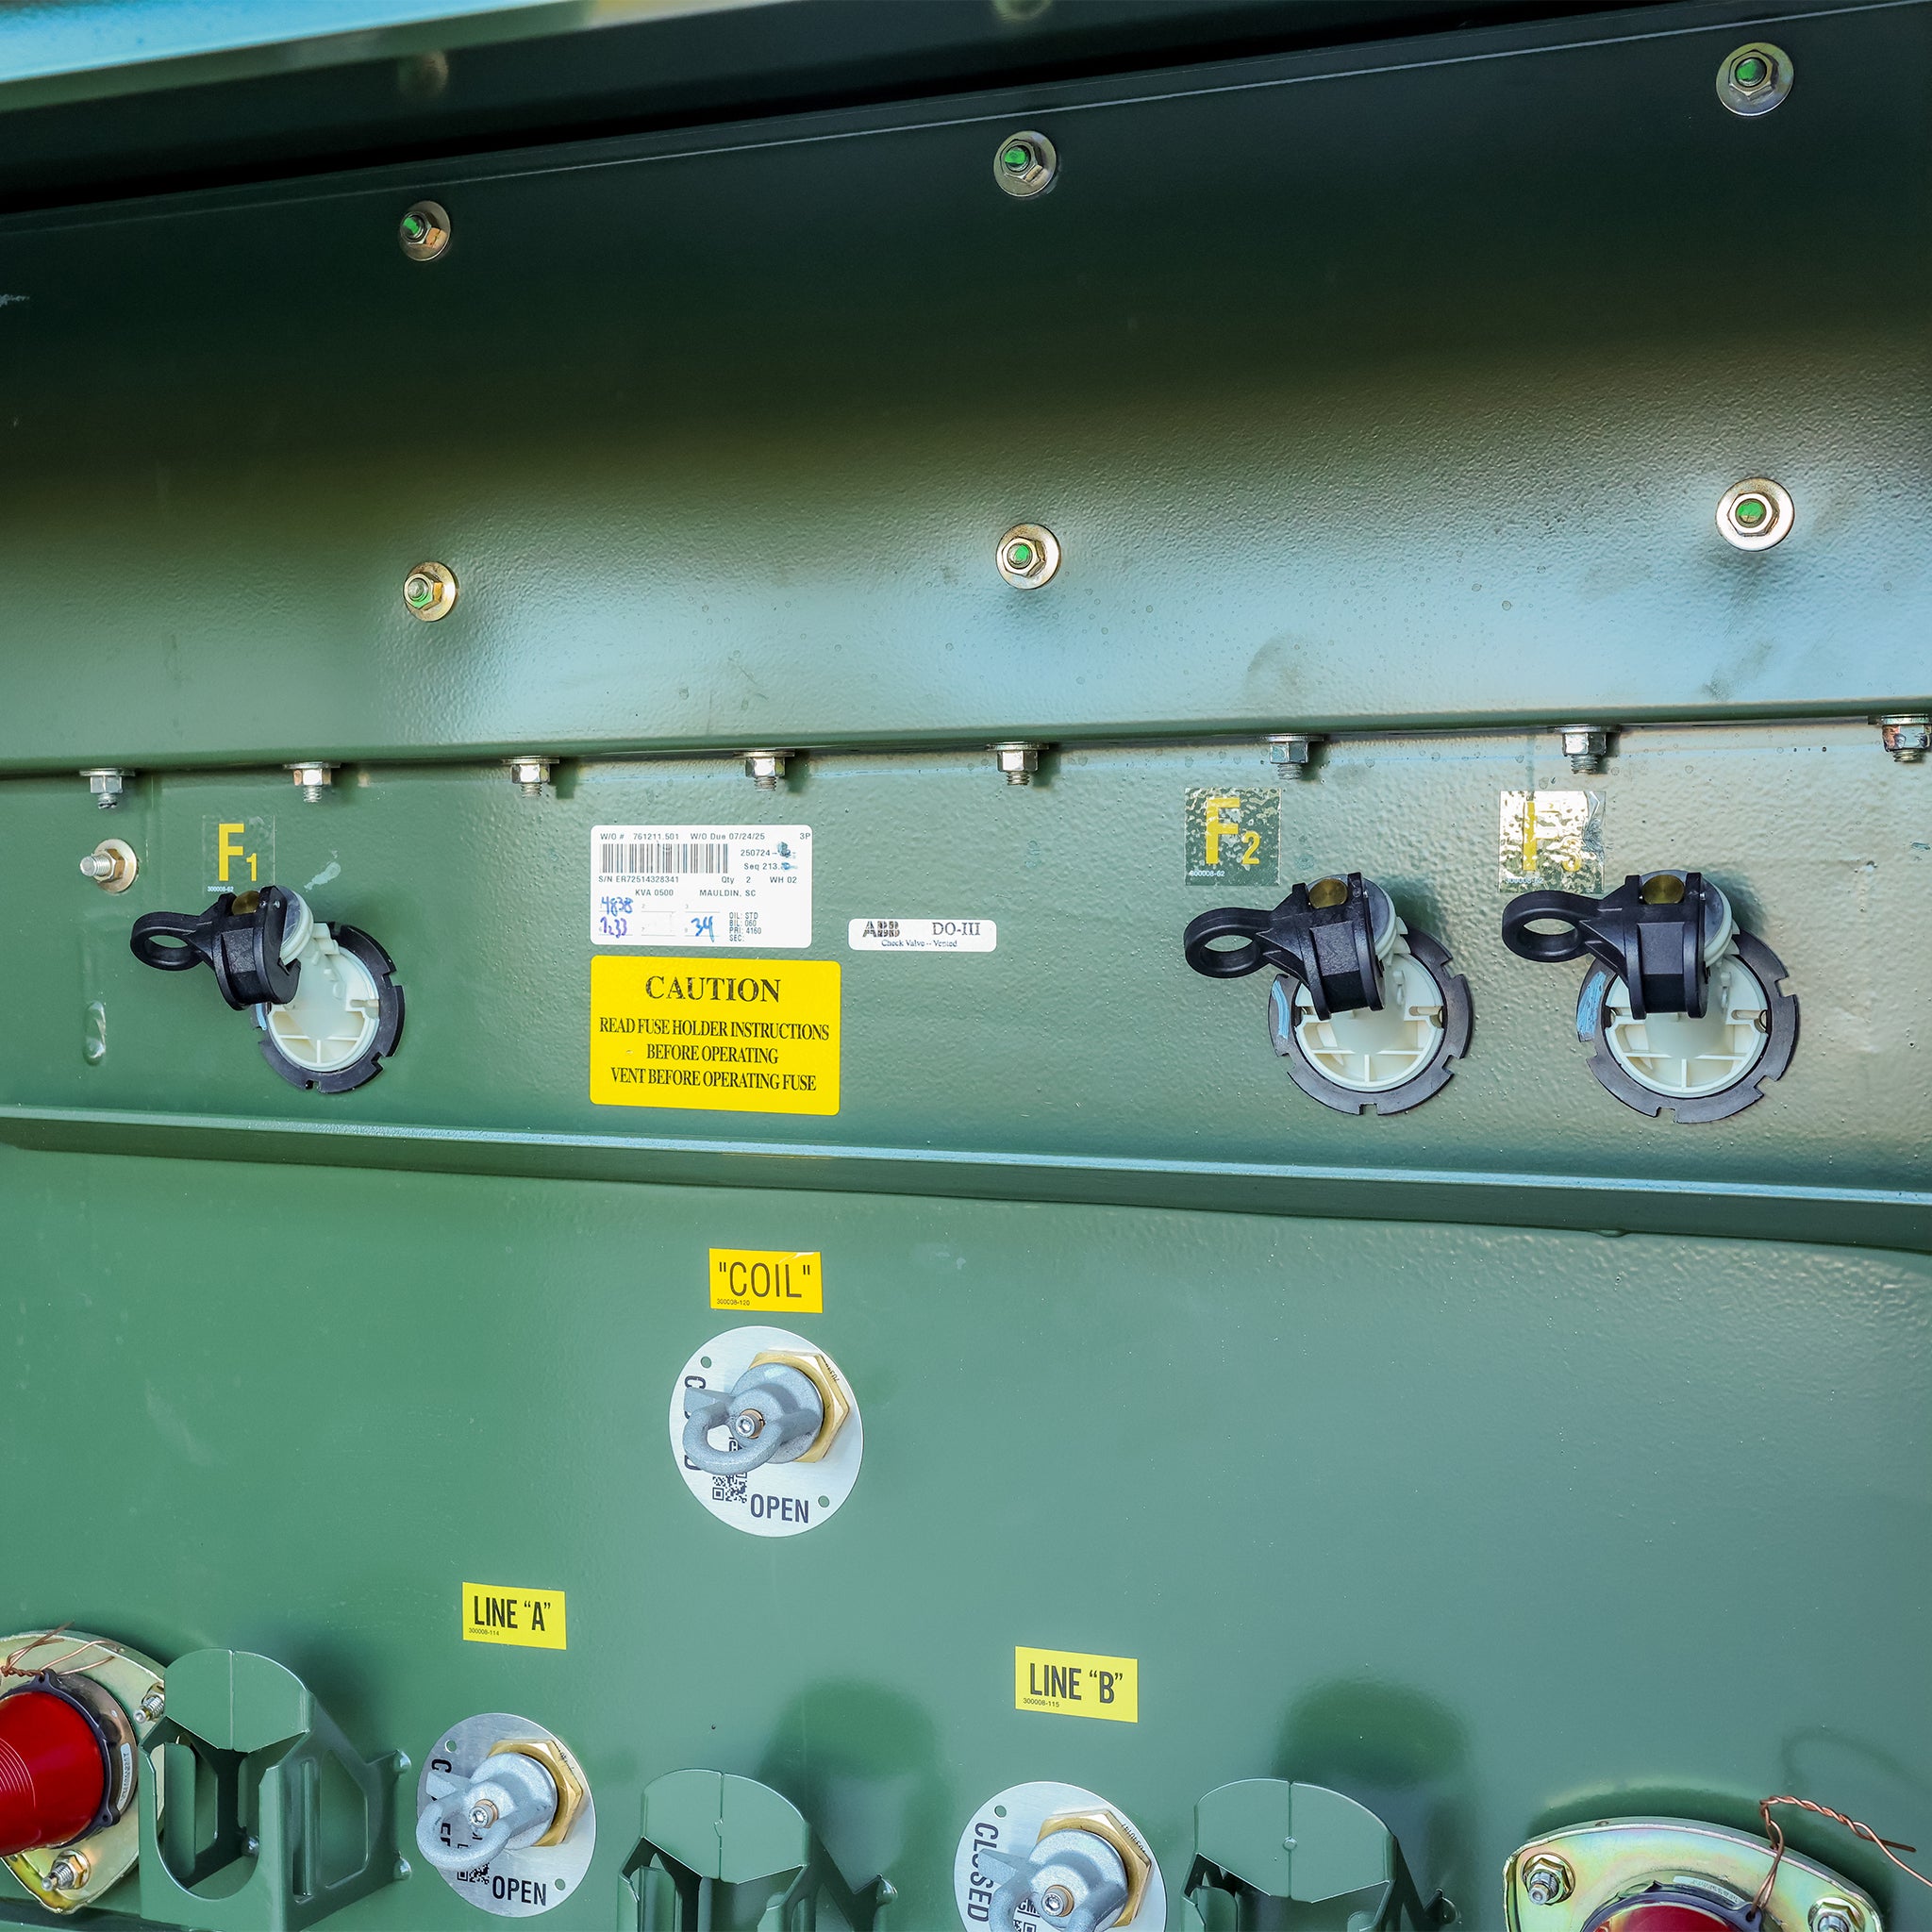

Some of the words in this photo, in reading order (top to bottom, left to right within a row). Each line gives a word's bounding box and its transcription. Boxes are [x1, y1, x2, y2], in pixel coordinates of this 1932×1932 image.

[799, 832, 811, 841] 3P
[1206, 797, 1260, 865] F2
[218, 823, 258, 882] F1
[932, 922, 981, 936] DO-III
[645, 974, 781, 1003] CAUTION
[599, 1016, 636, 1034] READ
[638, 1018, 671, 1036] FUSE
[673, 1019, 728, 1038] HOLDER
[731, 1022, 830, 1041] INSTRUCTIONS
[646, 1043, 699, 1061] BEFORE
[702, 1045, 779, 1065] OPERATING
[611, 1066, 647, 1084] VENT
[648, 1068, 701, 1087] BEFORE
[703, 1070, 780, 1091] OPERATING
[782, 1074, 817, 1091] FUSE
[719, 1261, 810, 1298] "COIL"
[750, 1493, 809, 1524] OPEN
[474, 1595, 519, 1629] LINE
[1029, 1662, 1082, 1700] LINE
[1023, 1697, 1060, 1707] 300008-115
[491, 1875, 547, 1907] OPEN
